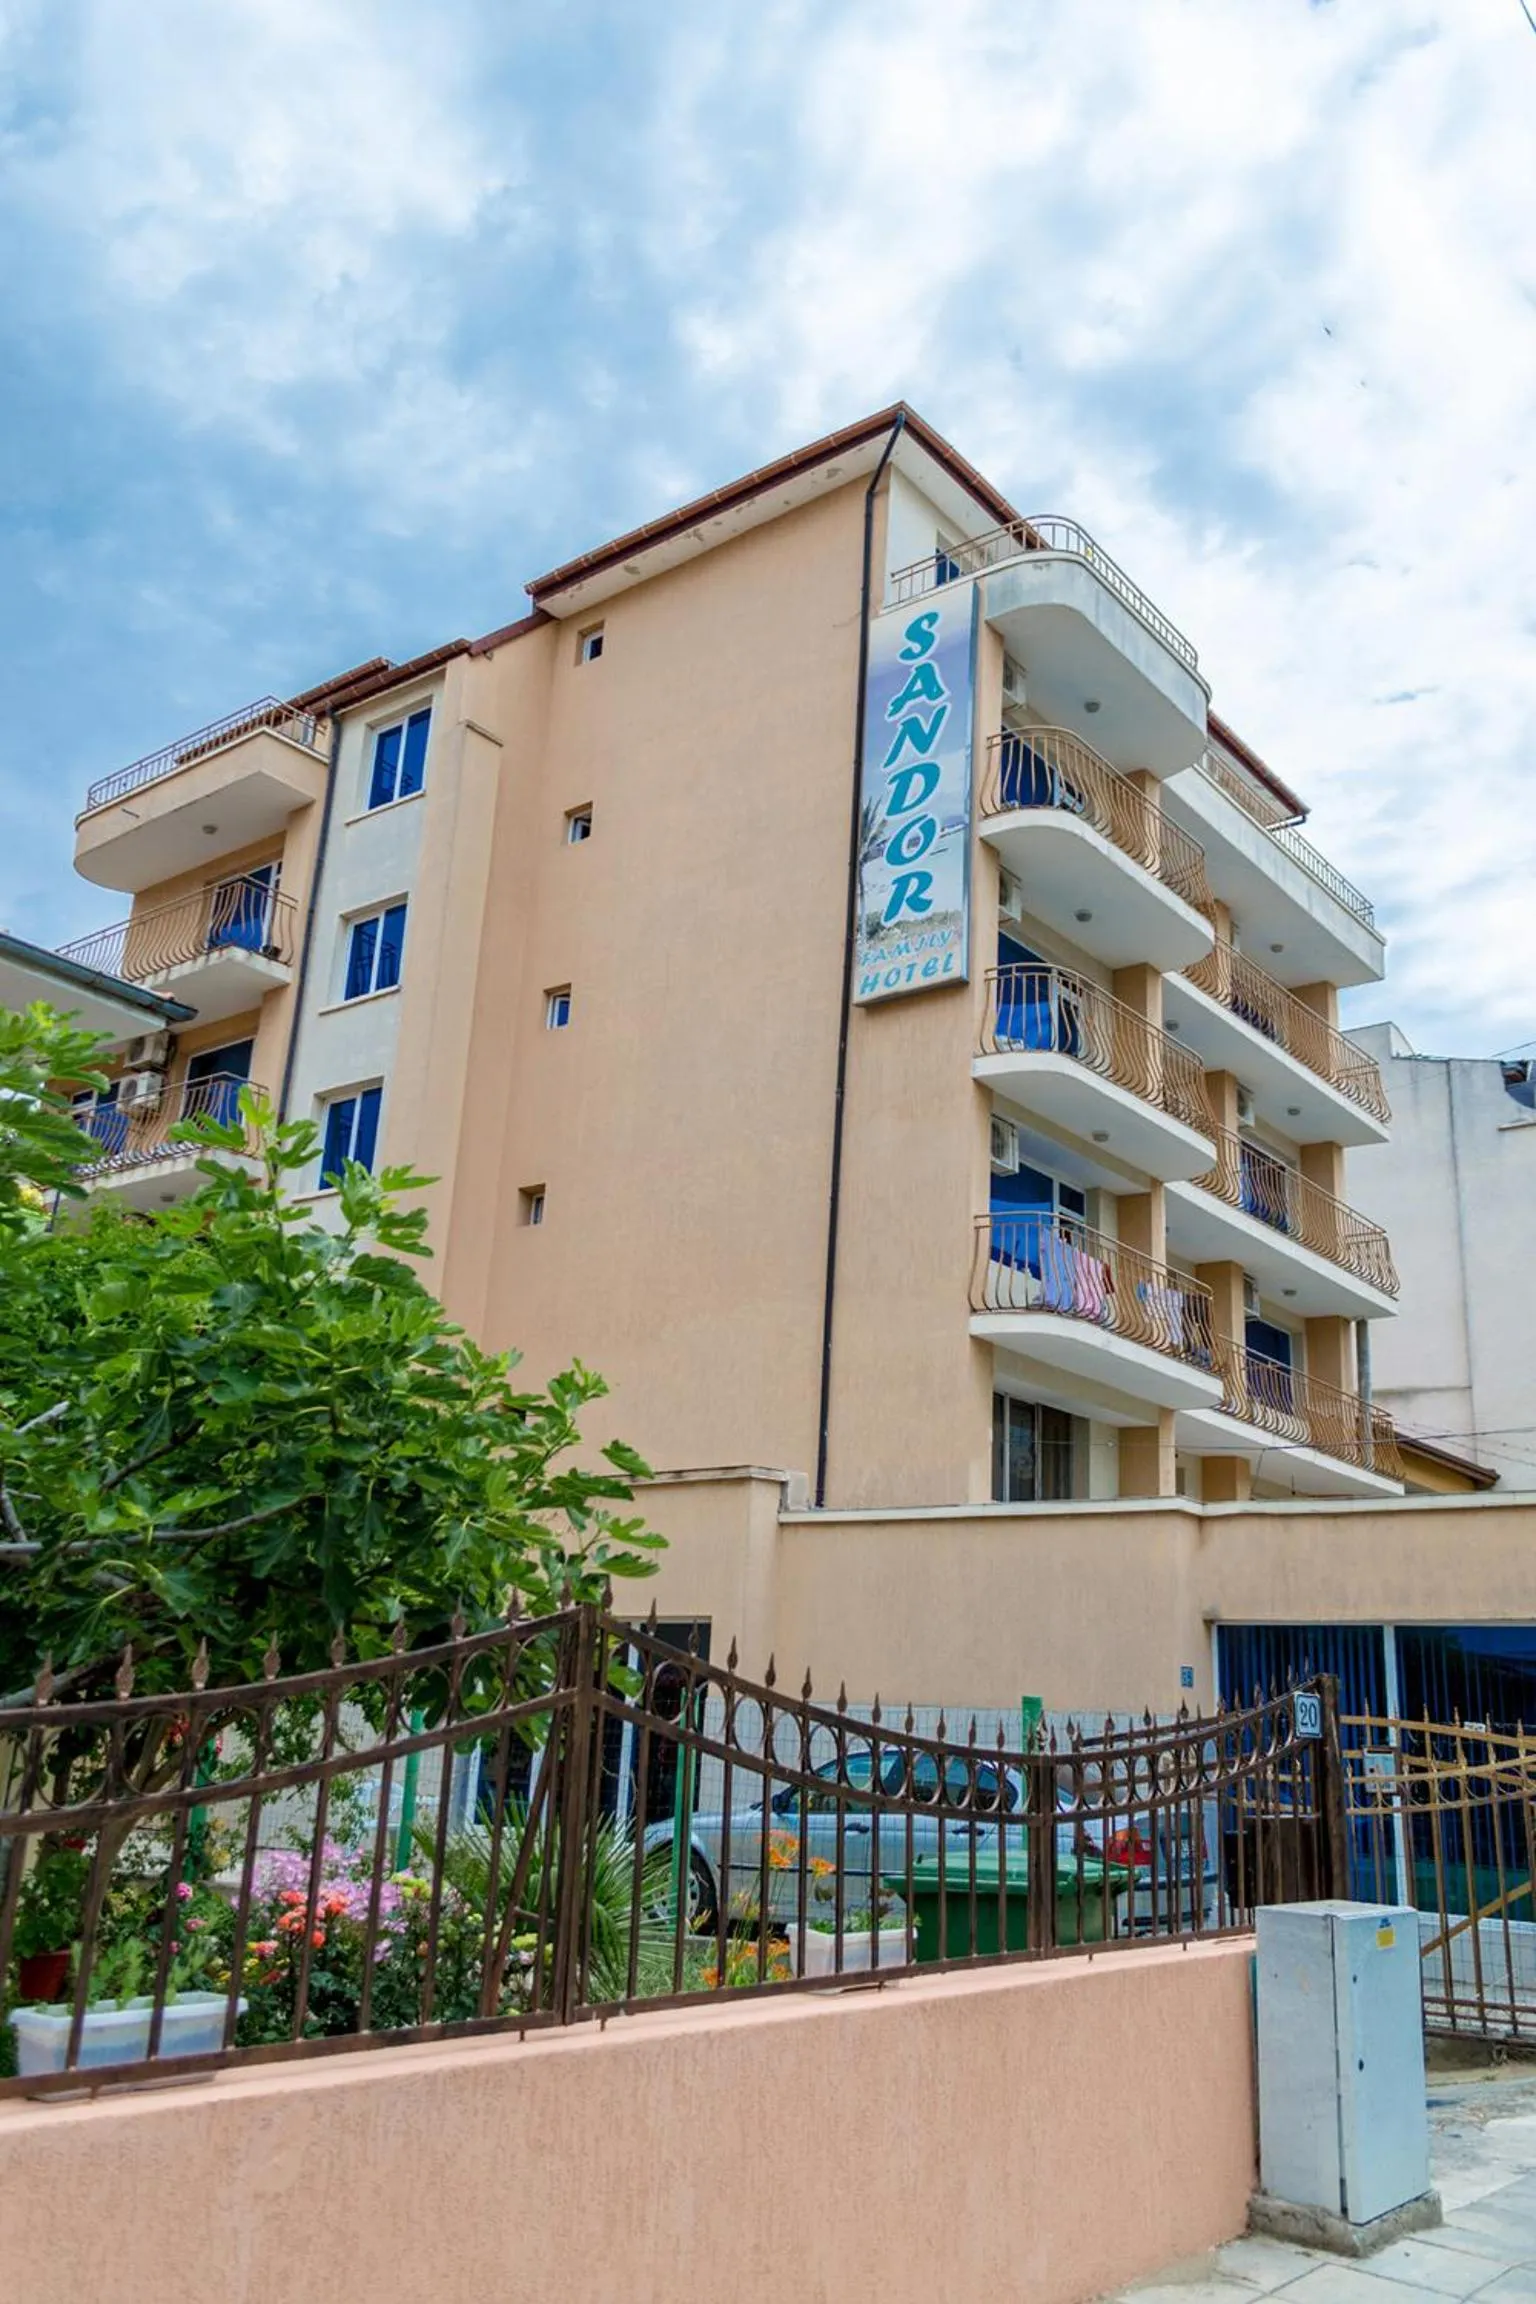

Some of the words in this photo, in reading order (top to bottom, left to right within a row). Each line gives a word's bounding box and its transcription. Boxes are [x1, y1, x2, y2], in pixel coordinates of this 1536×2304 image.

[882, 610, 949, 923] SANDOR
[861, 930, 953, 966] FAMILY
[1300, 1701, 1317, 1728] 20
